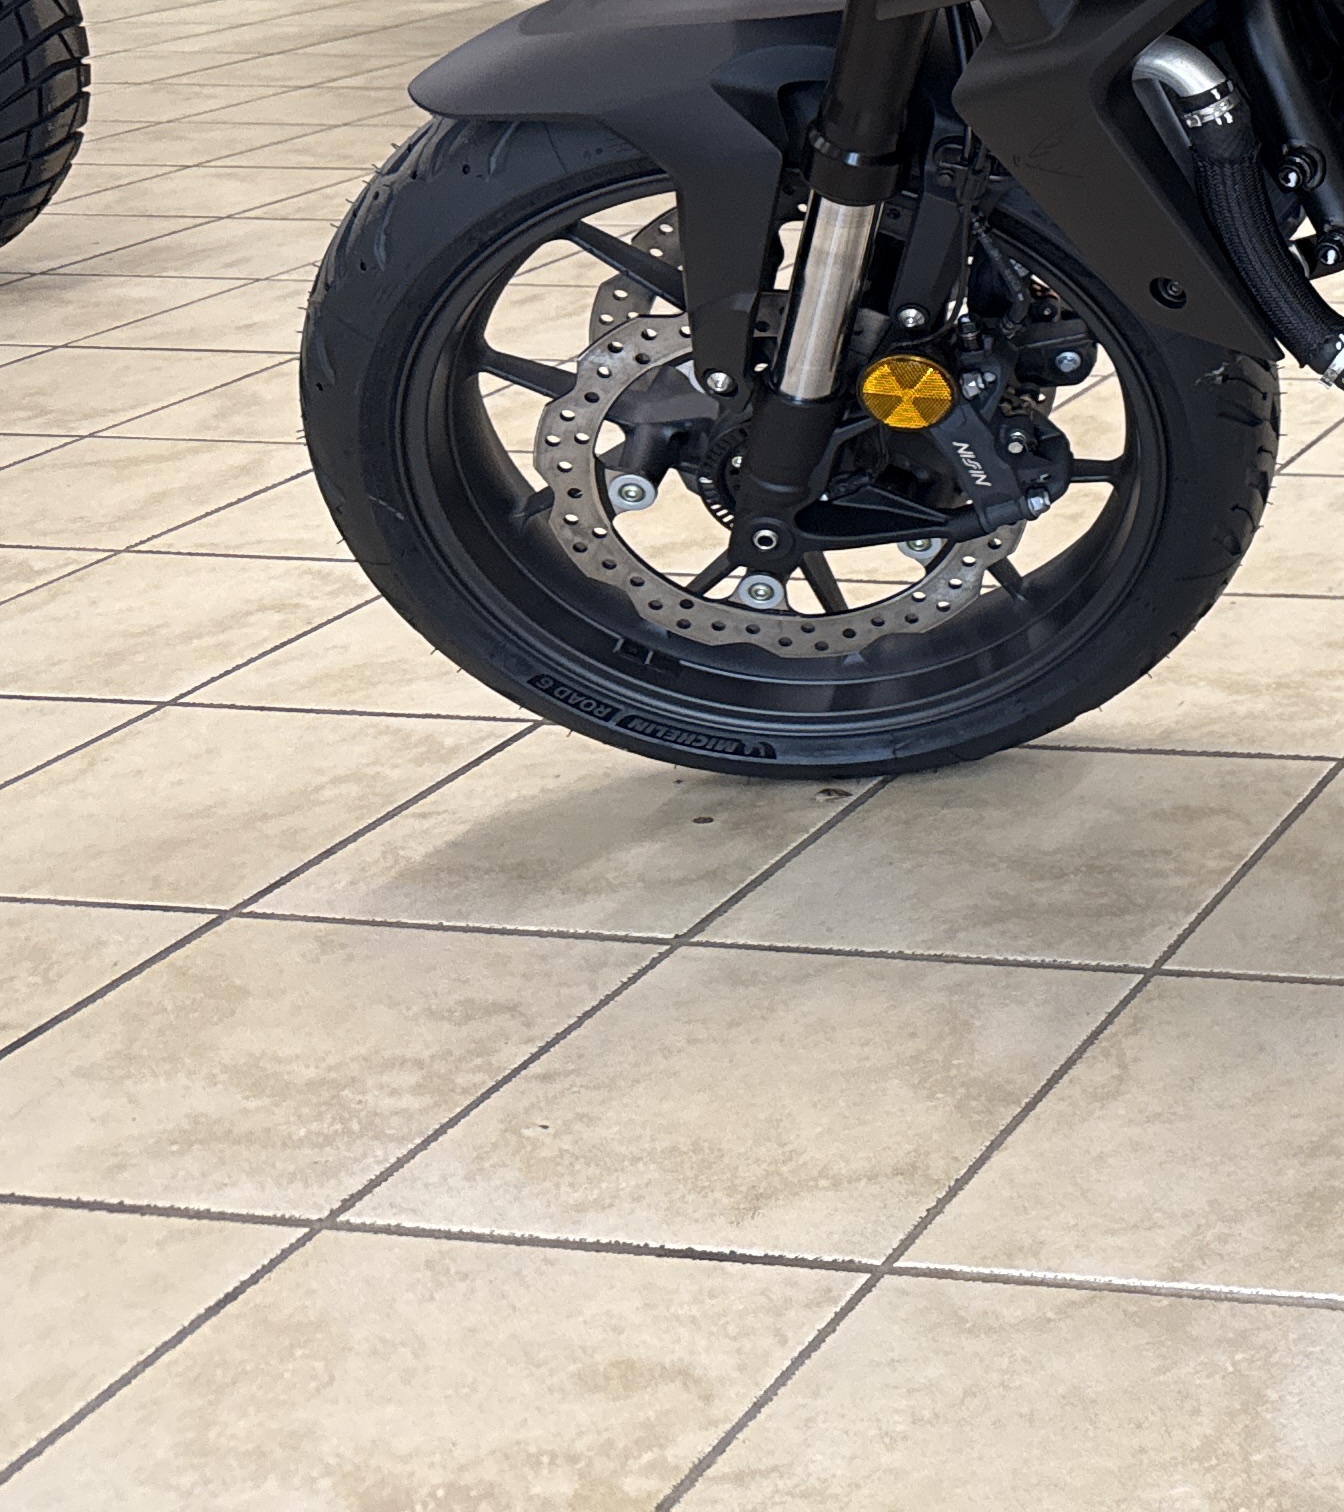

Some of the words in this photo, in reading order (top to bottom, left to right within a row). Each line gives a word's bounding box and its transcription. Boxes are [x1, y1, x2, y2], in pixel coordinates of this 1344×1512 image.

[535, 674, 554, 690] 6
[553, 684, 613, 717] ROAD
[626, 717, 737, 753] MICHELIN
